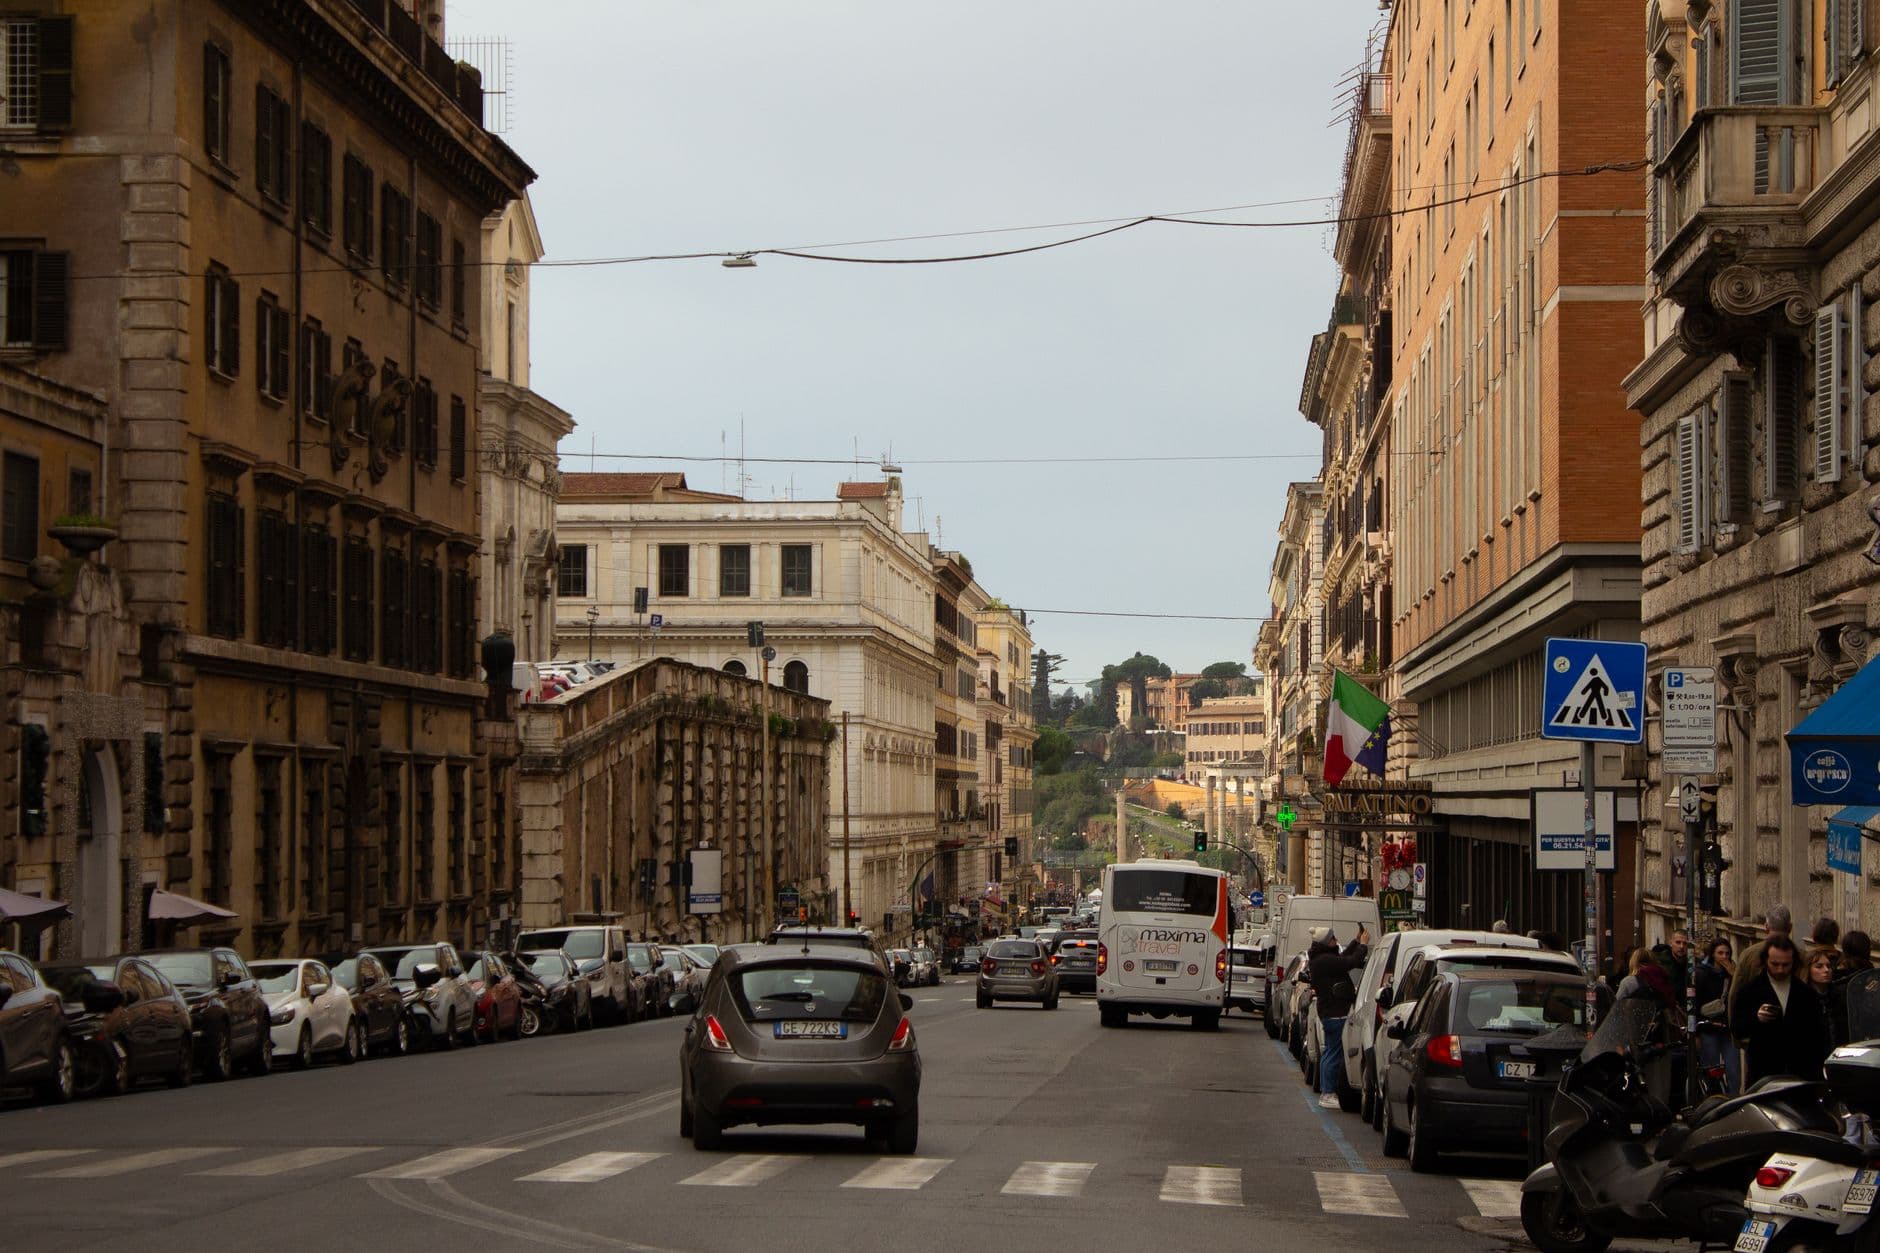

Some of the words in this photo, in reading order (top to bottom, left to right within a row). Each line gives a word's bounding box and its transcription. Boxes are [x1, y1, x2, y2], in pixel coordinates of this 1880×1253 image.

[653, 616, 660, 625] P
[1671, 674, 1681, 686] P
[1322, 792, 1433, 816] PALATINO
[1140, 928, 1206, 944] maxima
[1136, 940, 1182, 955] travel
[800, 1022, 839, 1034] 722KS
[1505, 1063, 1521, 1076] CZ
[1847, 1186, 1875, 1202] 56978
[1748, 1221, 1761, 1235] EL
